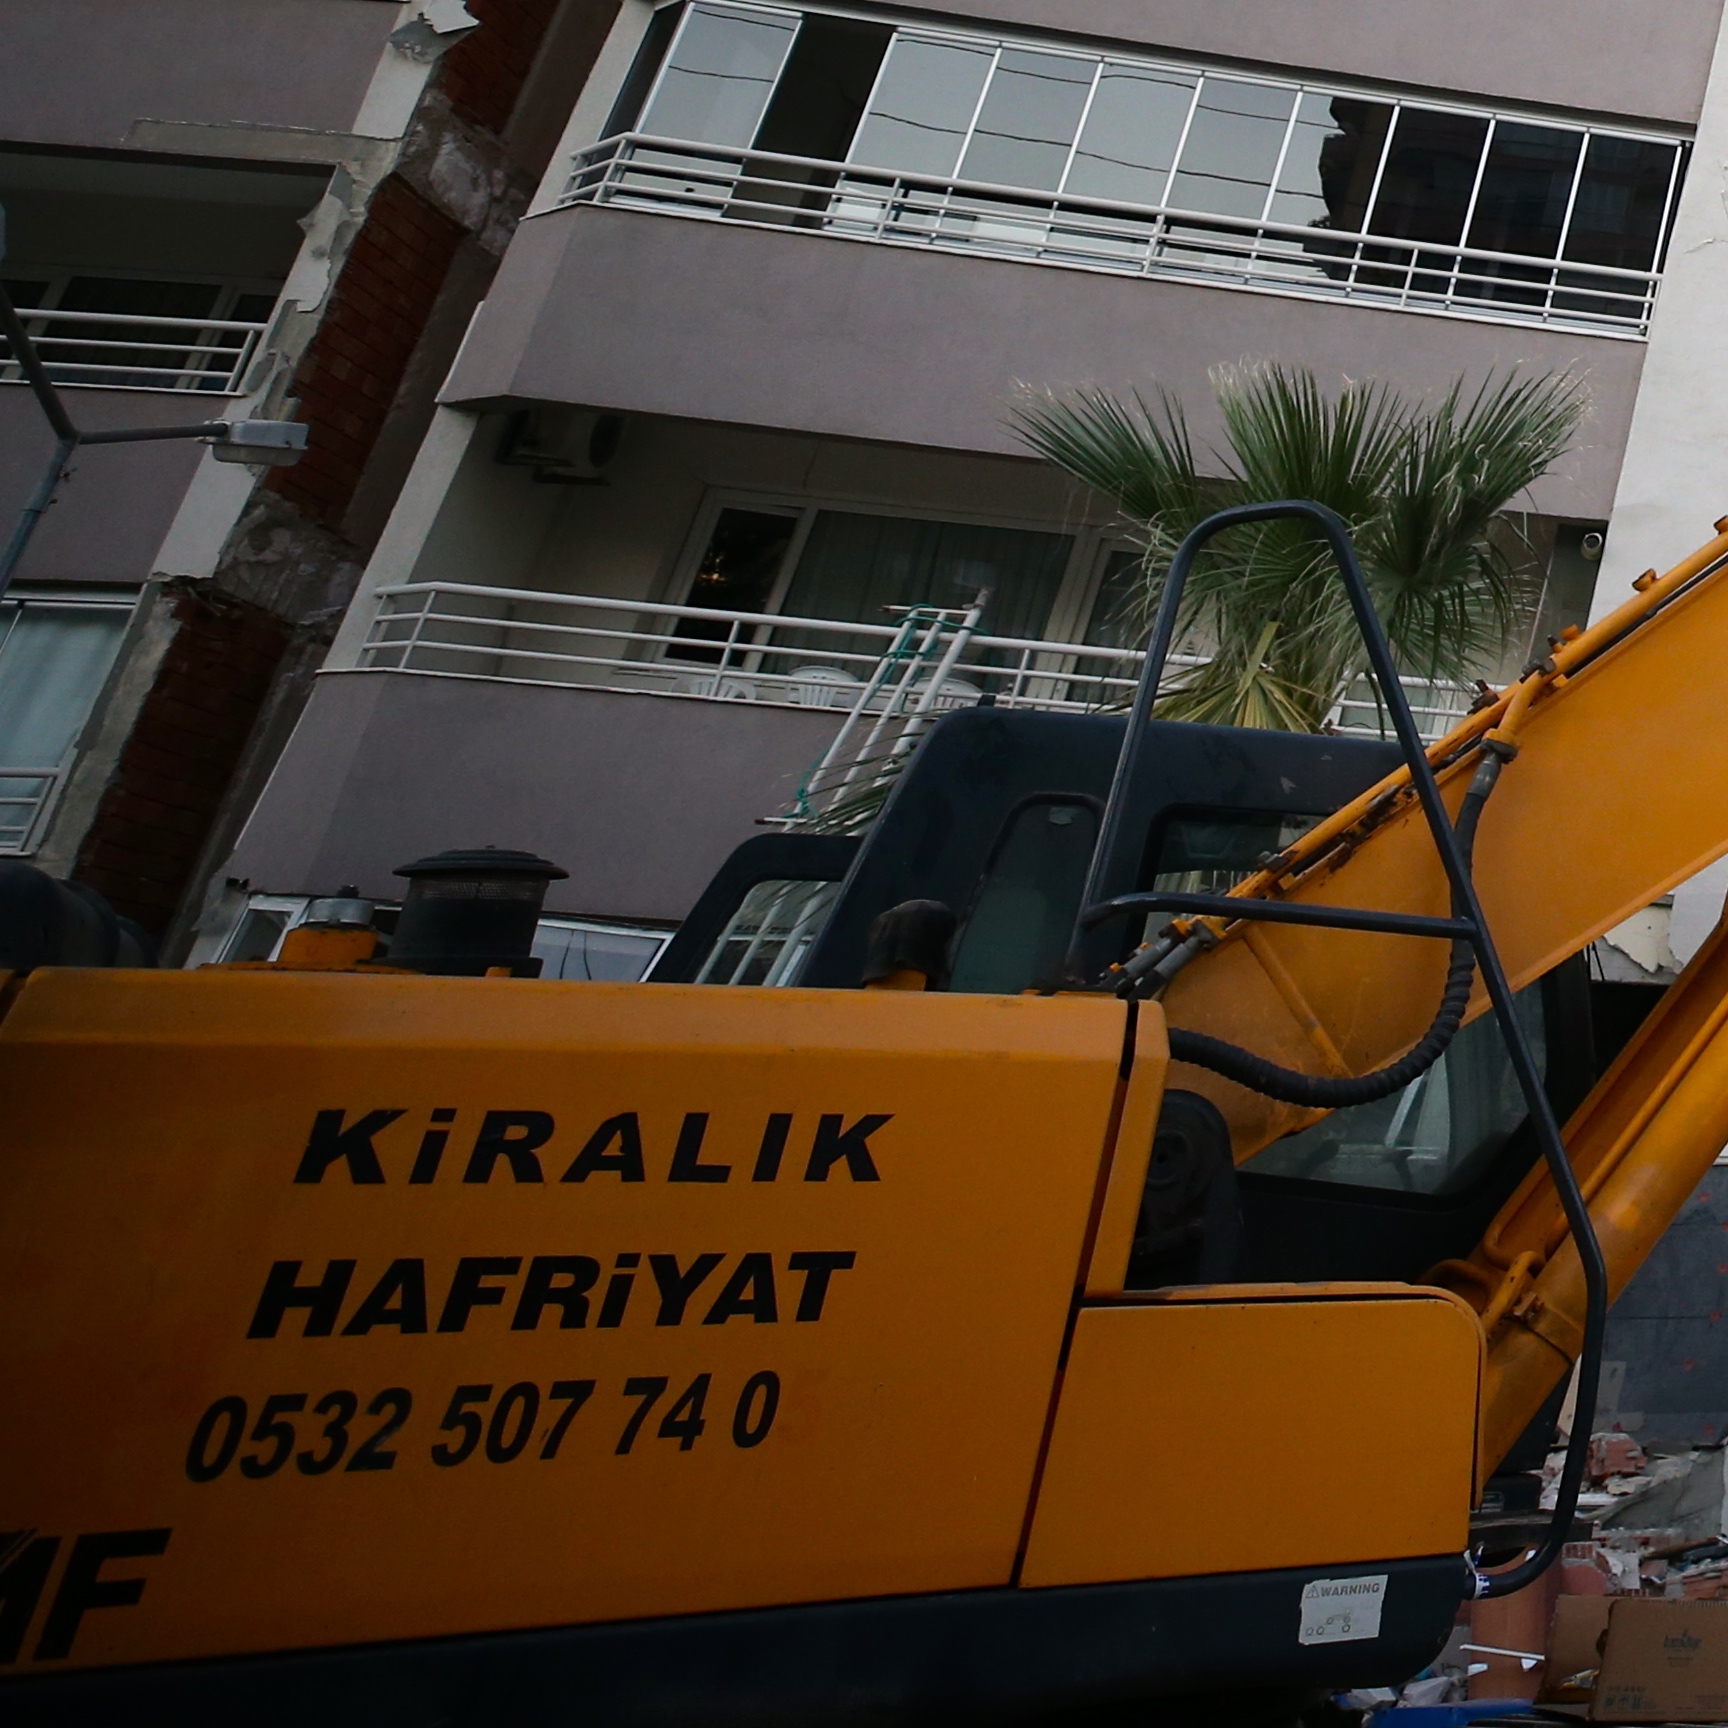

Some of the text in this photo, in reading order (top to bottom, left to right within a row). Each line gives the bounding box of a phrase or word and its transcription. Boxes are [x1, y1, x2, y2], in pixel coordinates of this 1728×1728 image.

[184, 1369, 784, 1485] 0532 507 74 0
[1321, 1583, 1381, 1598] WARNING
